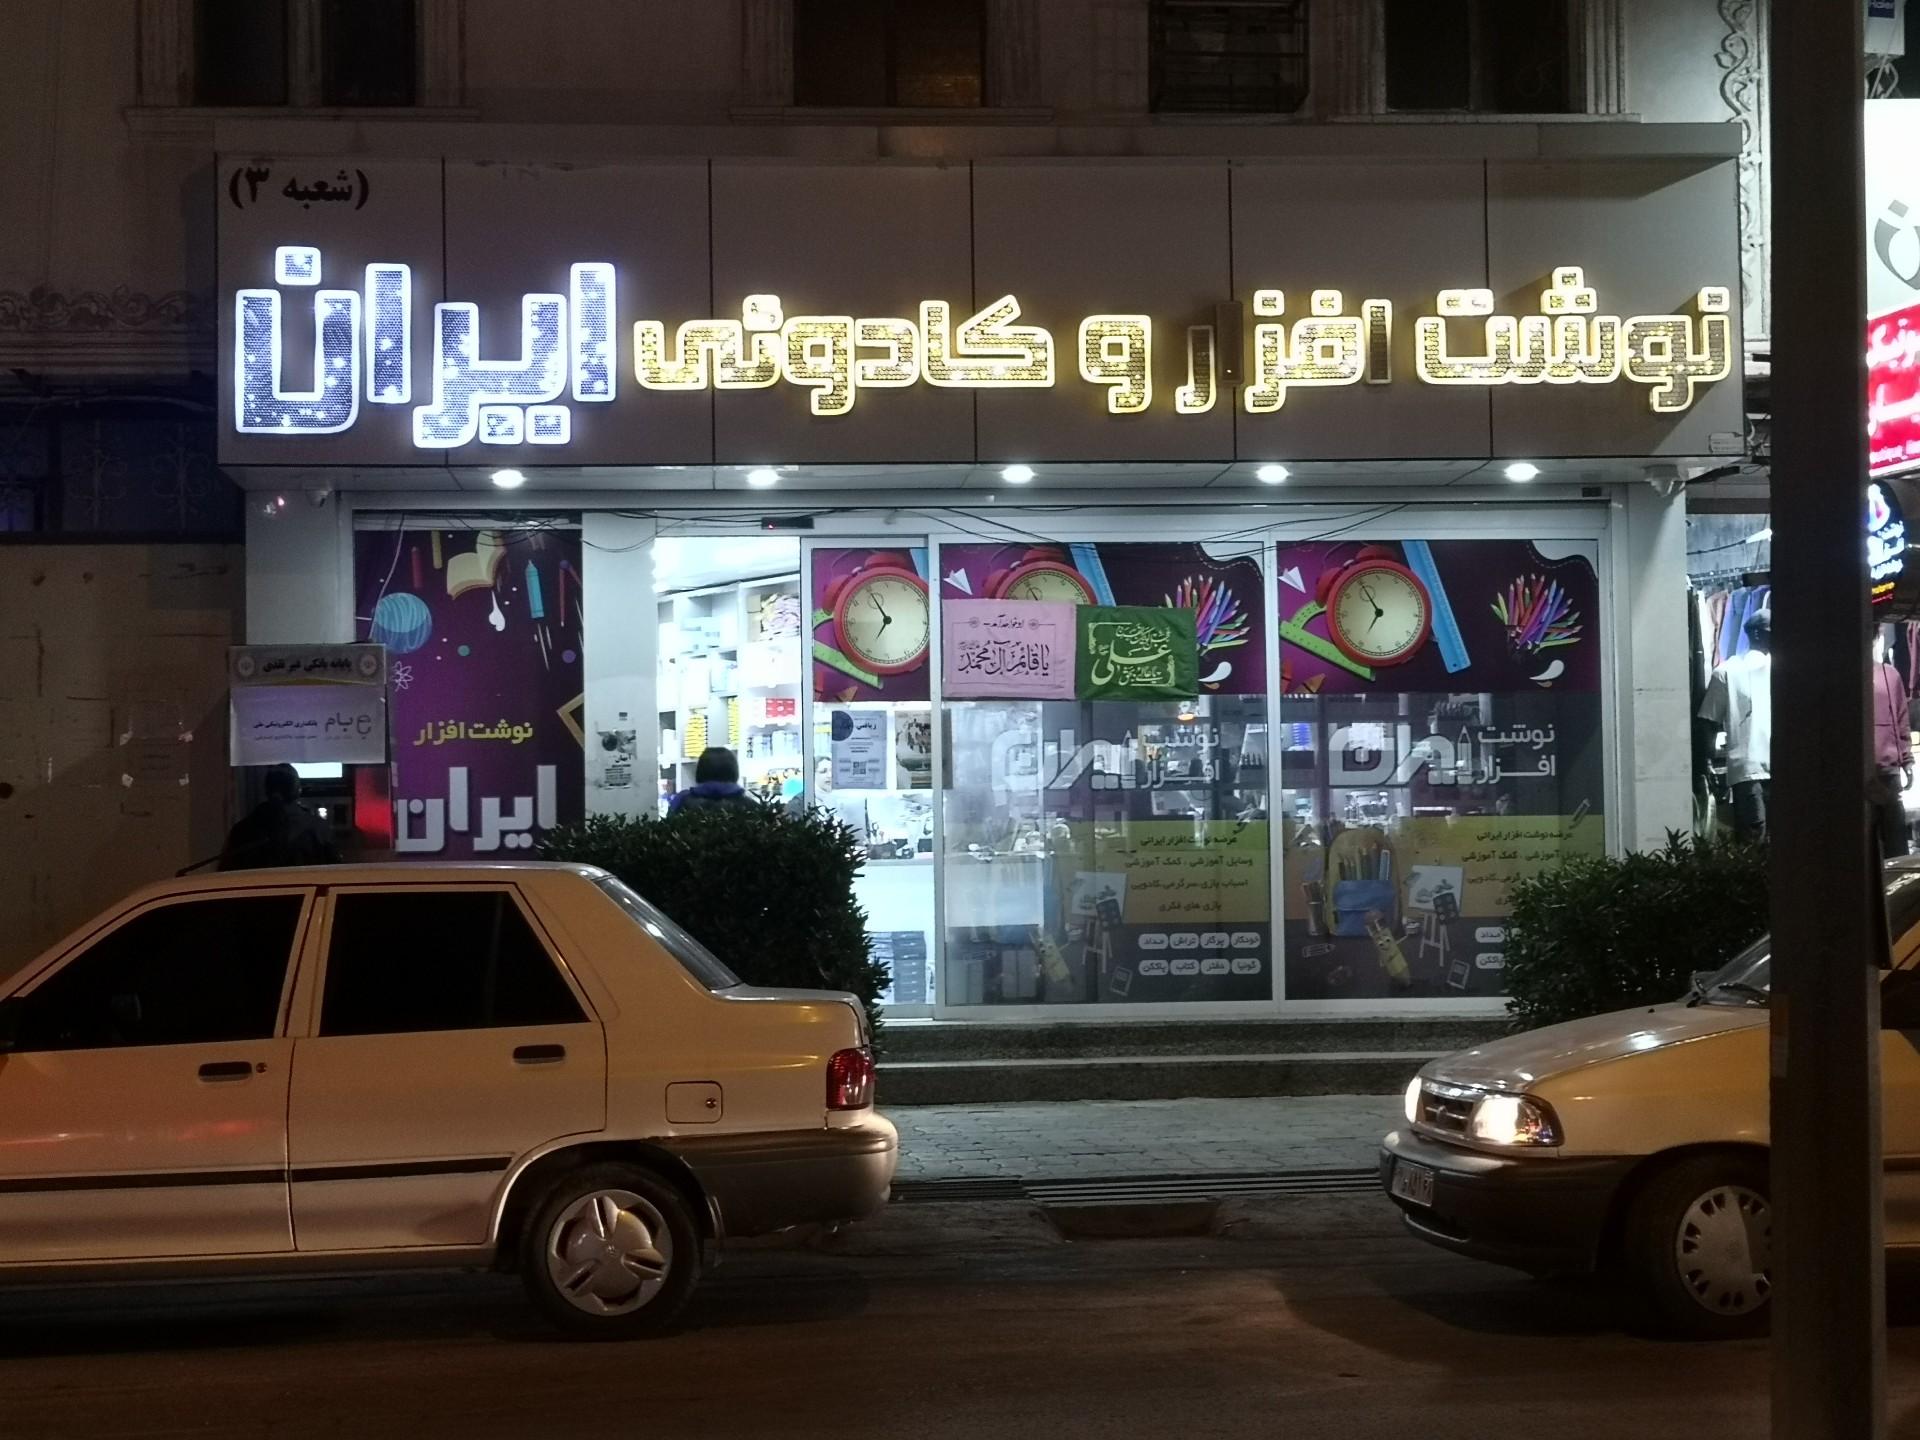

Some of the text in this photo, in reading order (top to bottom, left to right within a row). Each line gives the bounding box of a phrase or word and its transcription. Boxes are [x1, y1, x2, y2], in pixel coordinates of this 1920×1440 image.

[282, 169, 370, 211] (شعبه
[235, 246, 617, 449] ایران
[1078, 315, 1152, 414] و
[1415, 266, 1732, 413] نوشت
[413, 718, 534, 747] نوشت افزار
[394, 765, 557, 853] ایران
